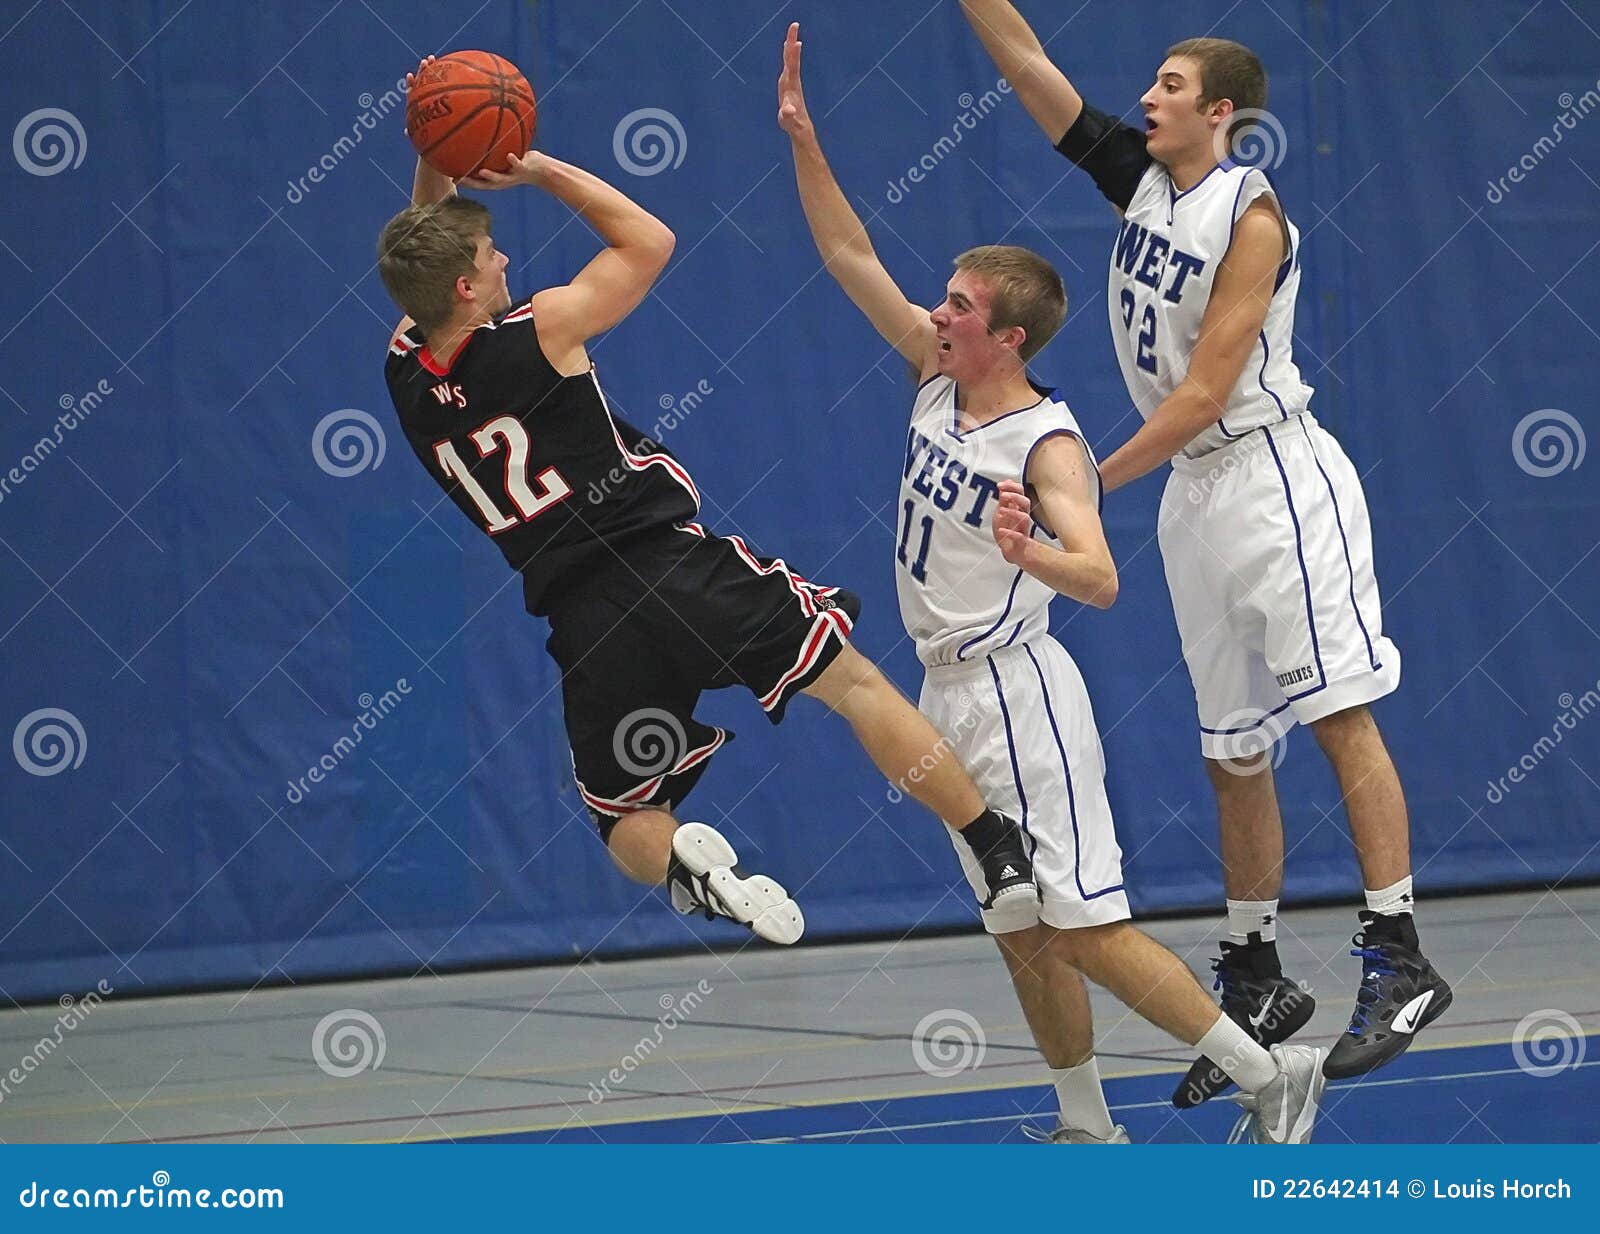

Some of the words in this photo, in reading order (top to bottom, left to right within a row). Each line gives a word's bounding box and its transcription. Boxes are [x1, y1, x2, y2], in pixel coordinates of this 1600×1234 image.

[1115, 219, 1206, 304] WET
[432, 413, 574, 536] 12
[897, 498, 934, 586] 11
